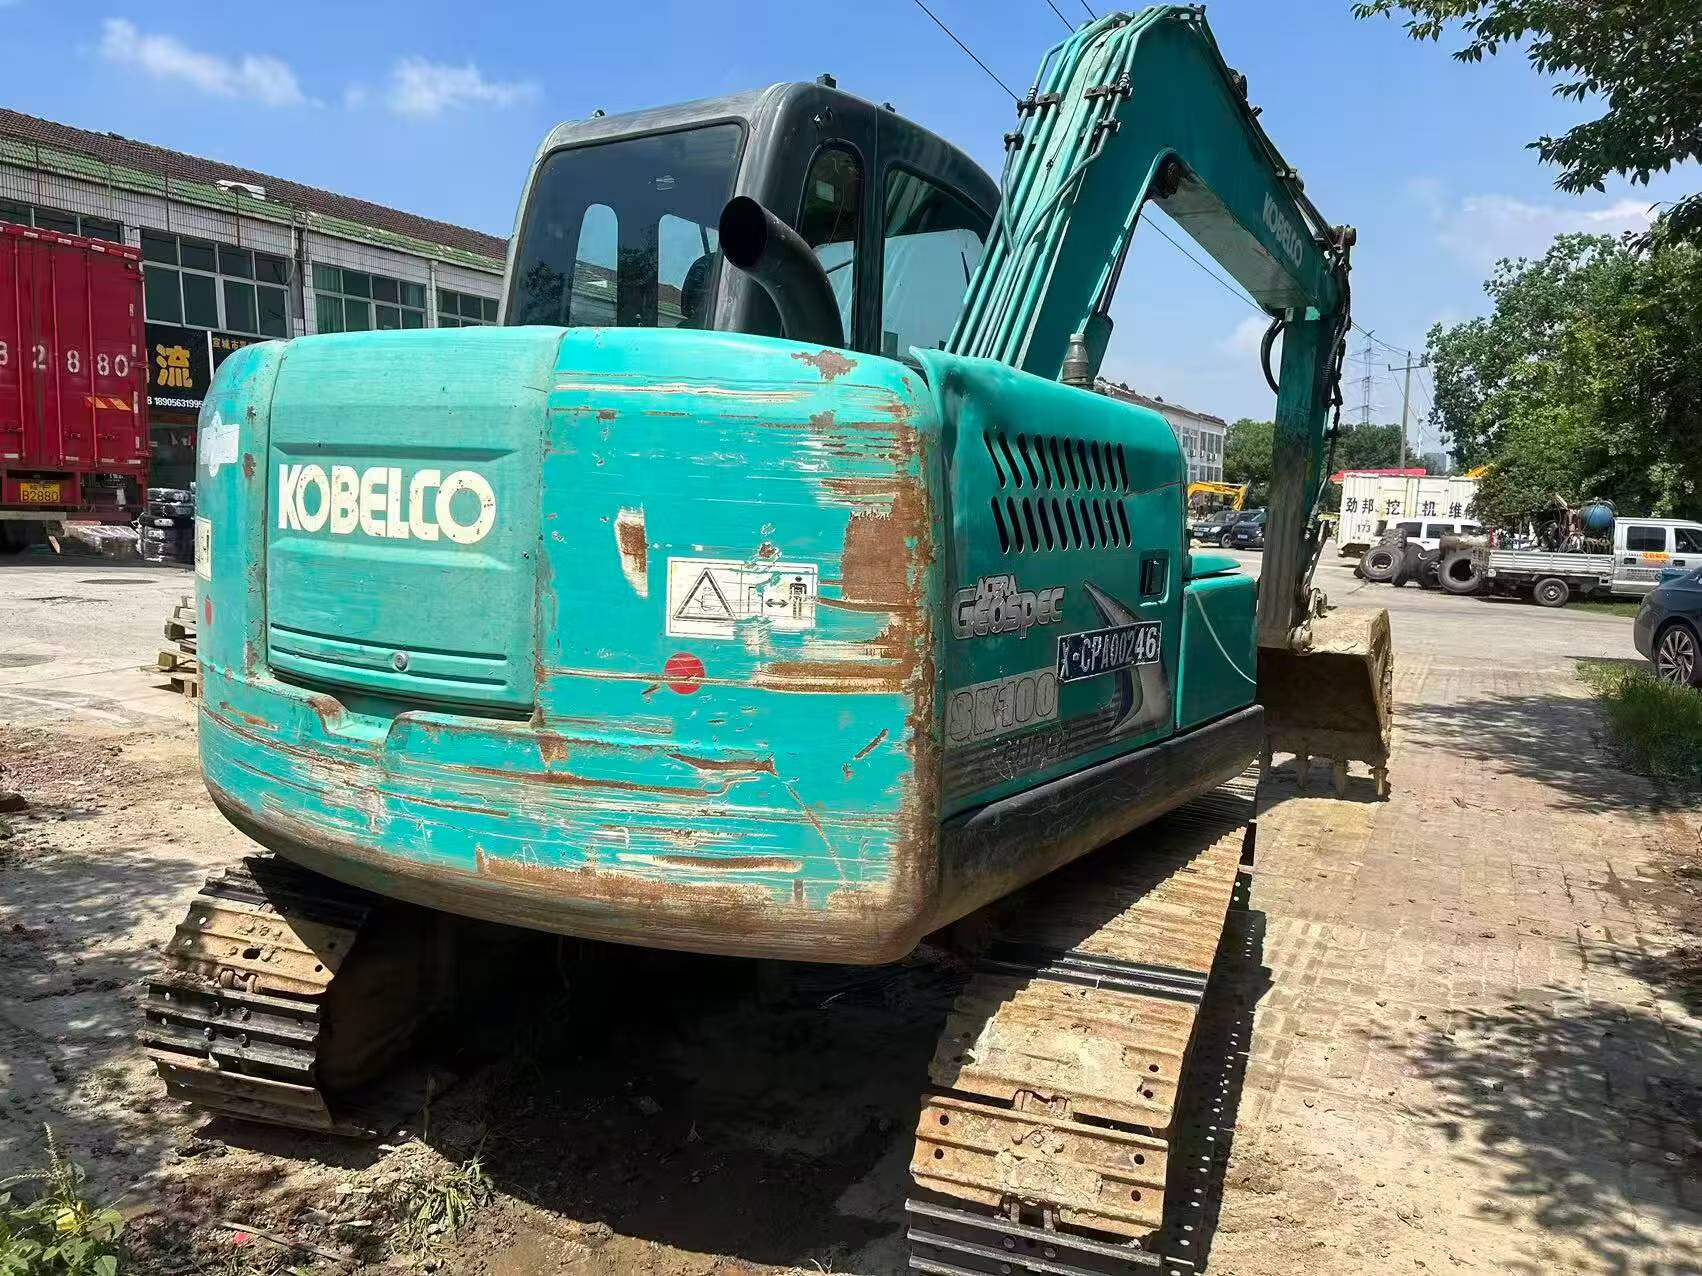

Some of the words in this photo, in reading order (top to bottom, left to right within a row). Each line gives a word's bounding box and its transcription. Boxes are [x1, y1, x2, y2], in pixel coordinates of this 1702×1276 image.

[1262, 191, 1303, 268] KOBELCO
[22, 490, 60, 502] B2880
[278, 463, 496, 545] KOBELCO
[1357, 524, 1371, 533] 173
